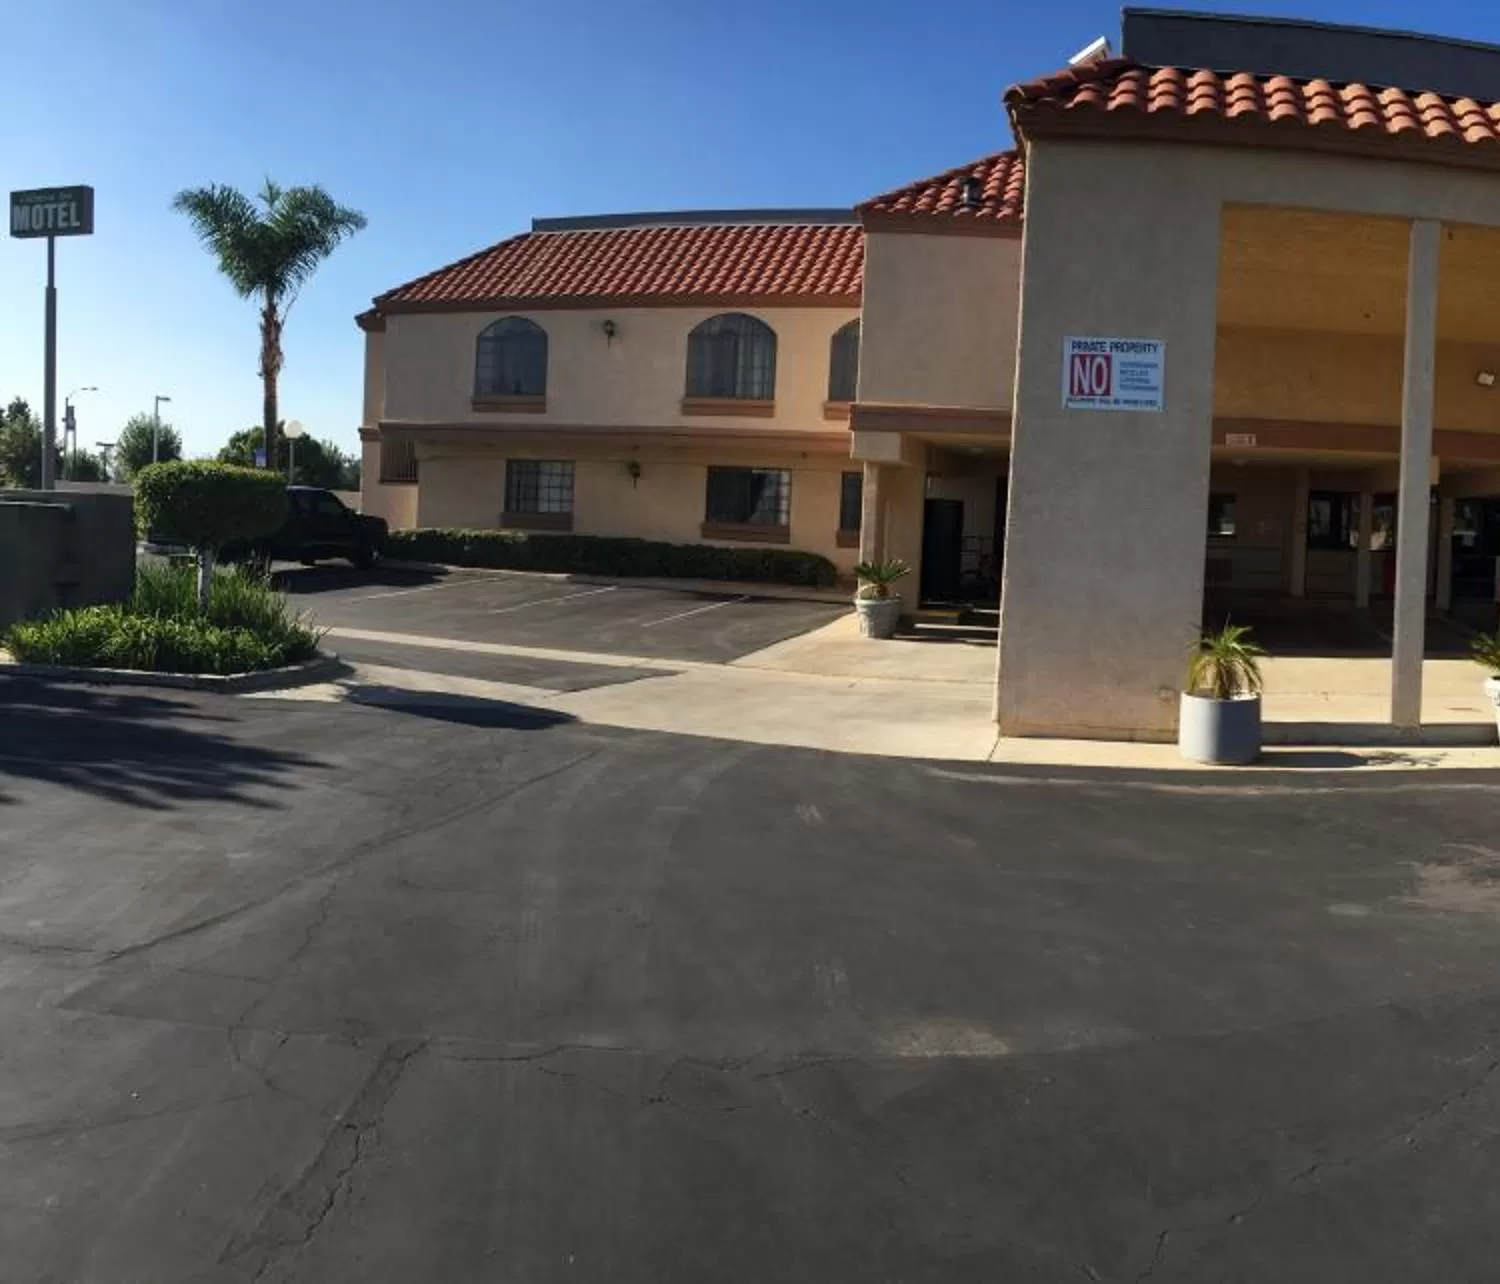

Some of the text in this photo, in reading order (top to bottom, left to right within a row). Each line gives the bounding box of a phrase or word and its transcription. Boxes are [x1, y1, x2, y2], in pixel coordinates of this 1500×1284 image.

[13, 201, 81, 231] MOTEL
[1072, 341, 1158, 353] PRIVATE PROPERTY
[1073, 355, 1108, 395] NO
